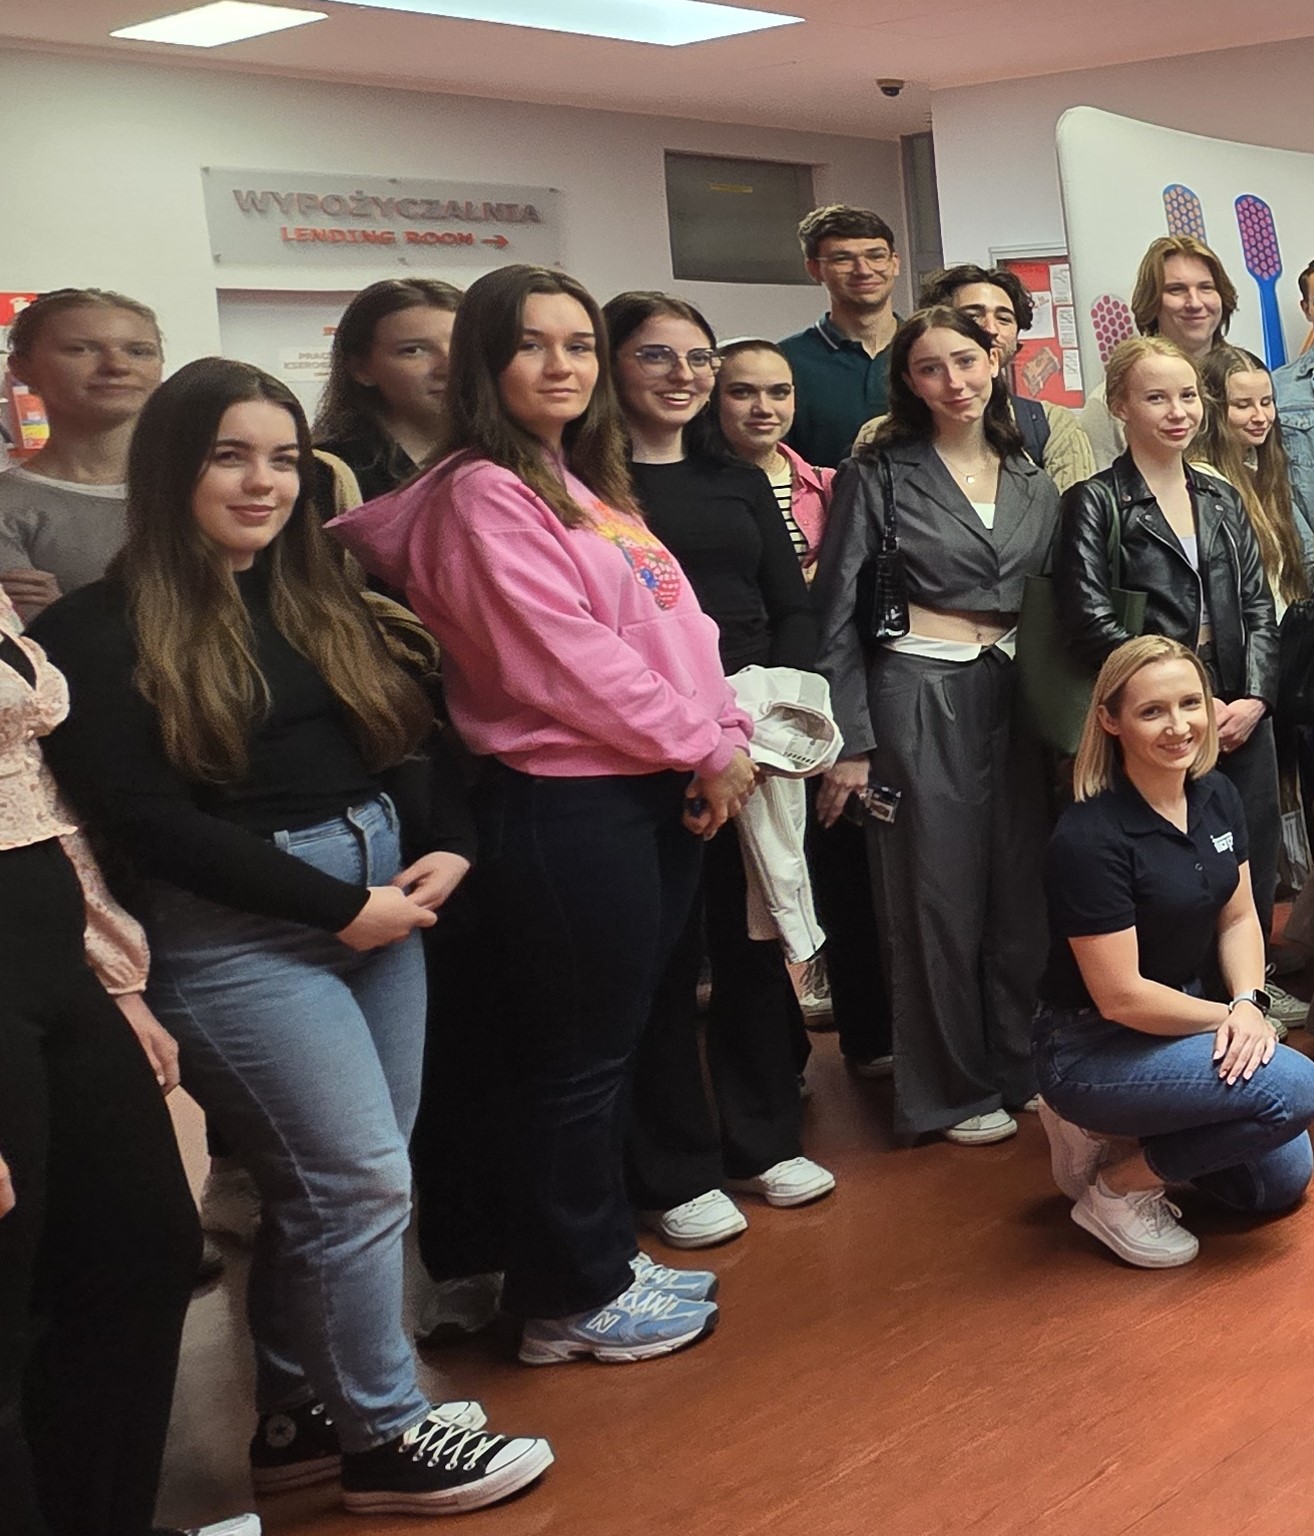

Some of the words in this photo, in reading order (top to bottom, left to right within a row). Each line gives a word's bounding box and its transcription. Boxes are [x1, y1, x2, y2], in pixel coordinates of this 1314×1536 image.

[232, 190, 541, 223] WYPOŻYCZALNIA
[280, 226, 396, 246] LENDING
[404, 231, 474, 246] ROOM
